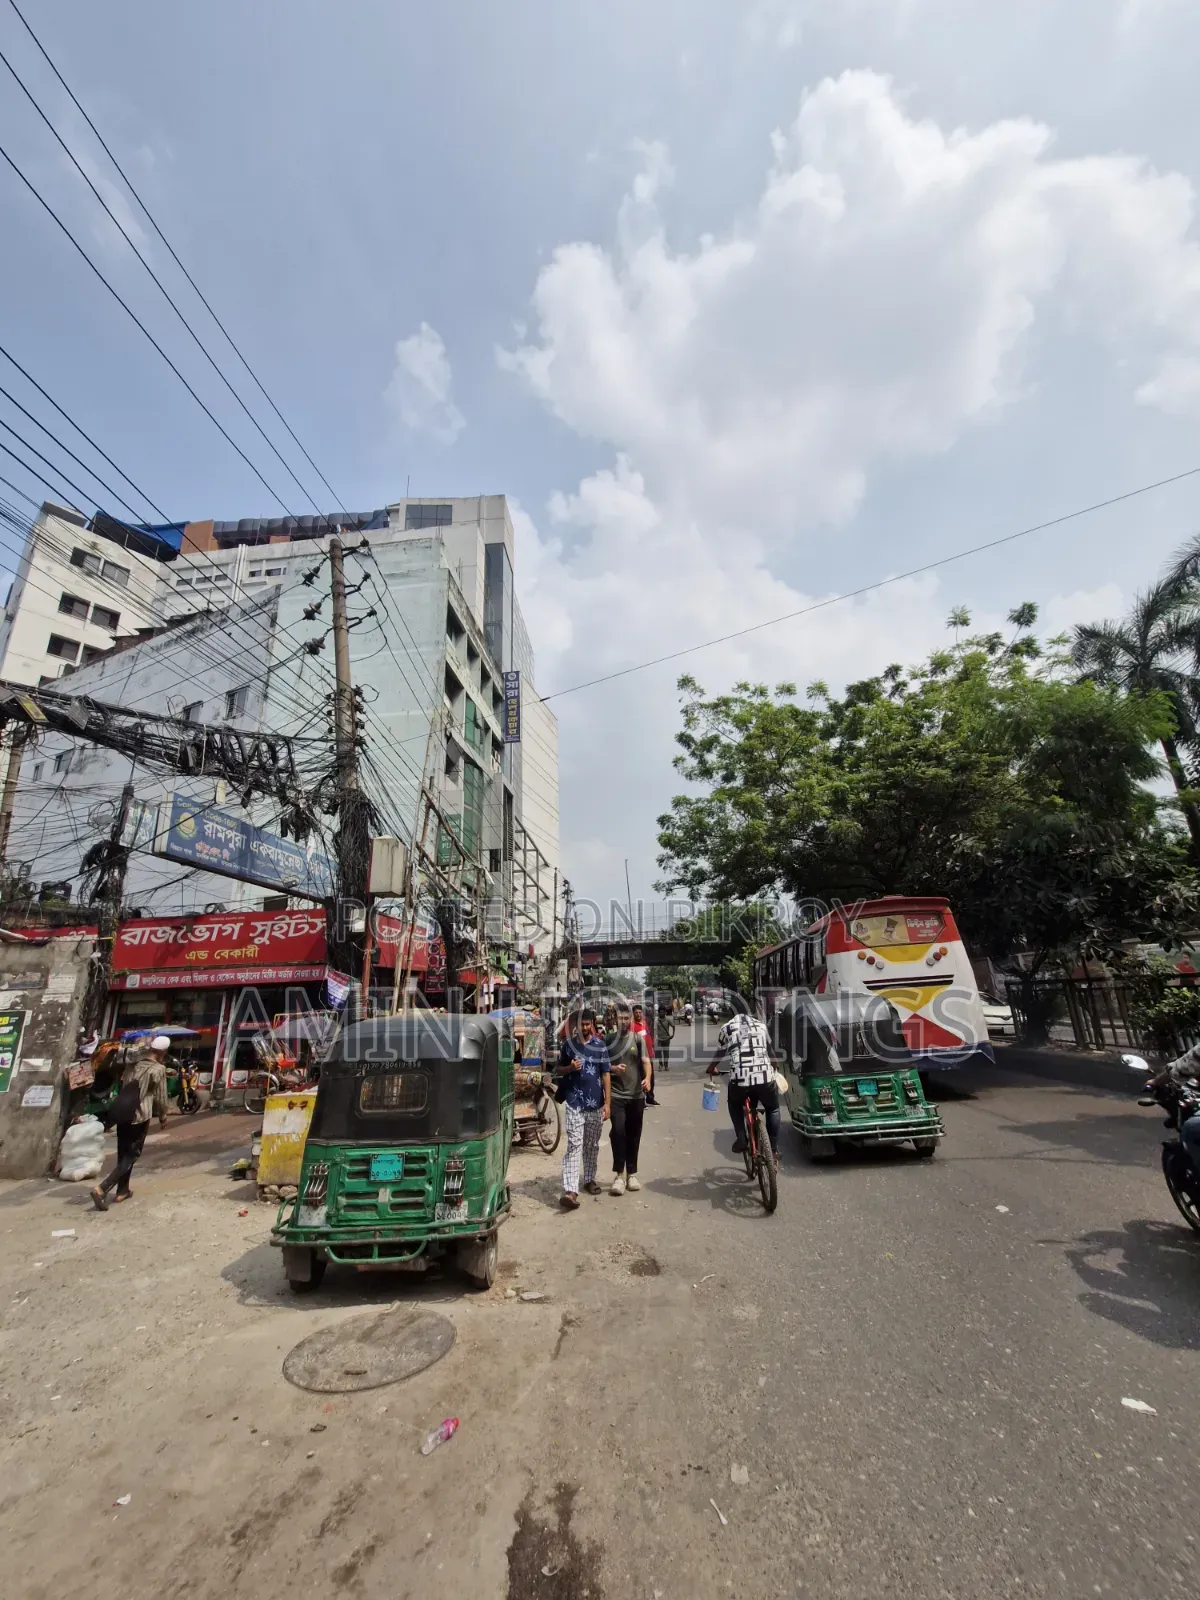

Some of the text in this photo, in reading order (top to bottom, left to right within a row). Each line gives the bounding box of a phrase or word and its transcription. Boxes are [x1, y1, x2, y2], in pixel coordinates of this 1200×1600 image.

[202, 818, 247, 851] রামপুরা
[120, 921, 244, 946] রাজভোগ
[185, 945, 260, 961] এন্ড বেকারী
[181, 975, 192, 984] এবং
